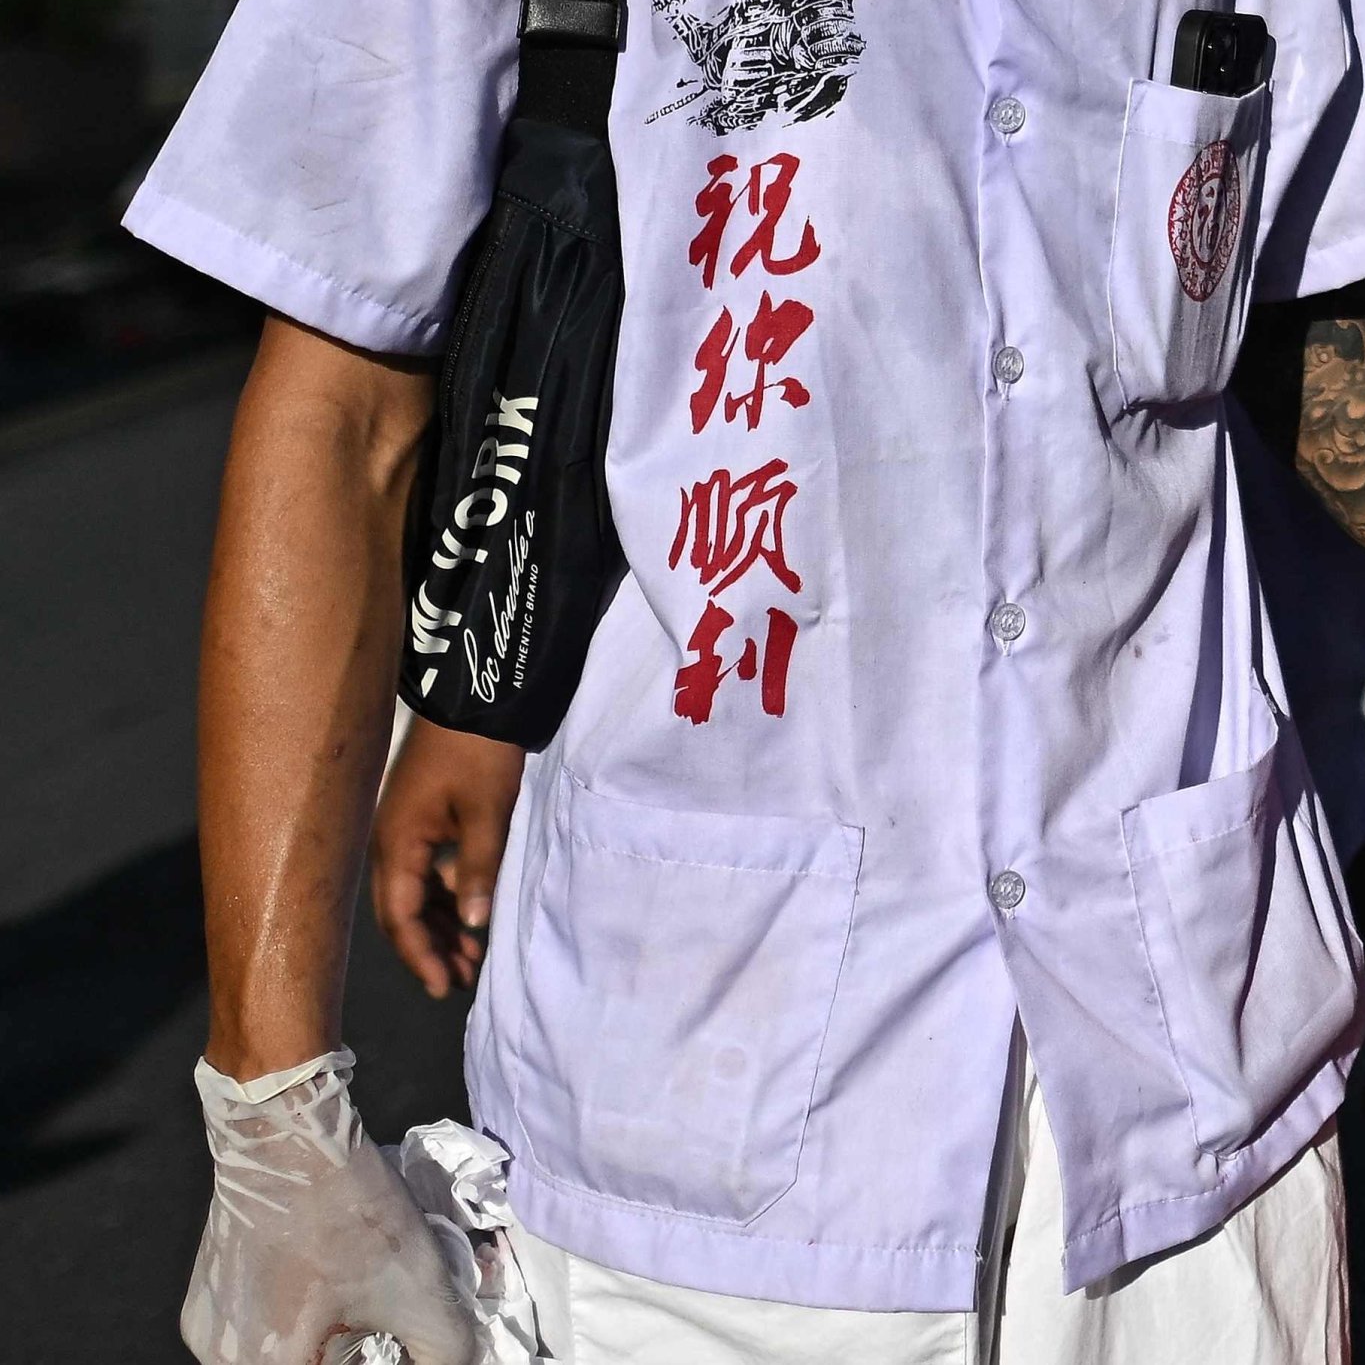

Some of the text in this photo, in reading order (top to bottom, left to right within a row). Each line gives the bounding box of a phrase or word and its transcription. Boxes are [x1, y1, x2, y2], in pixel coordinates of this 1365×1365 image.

[432, 388, 539, 570] YORK
[513, 563, 540, 689] AUTHENTIC BRAND
